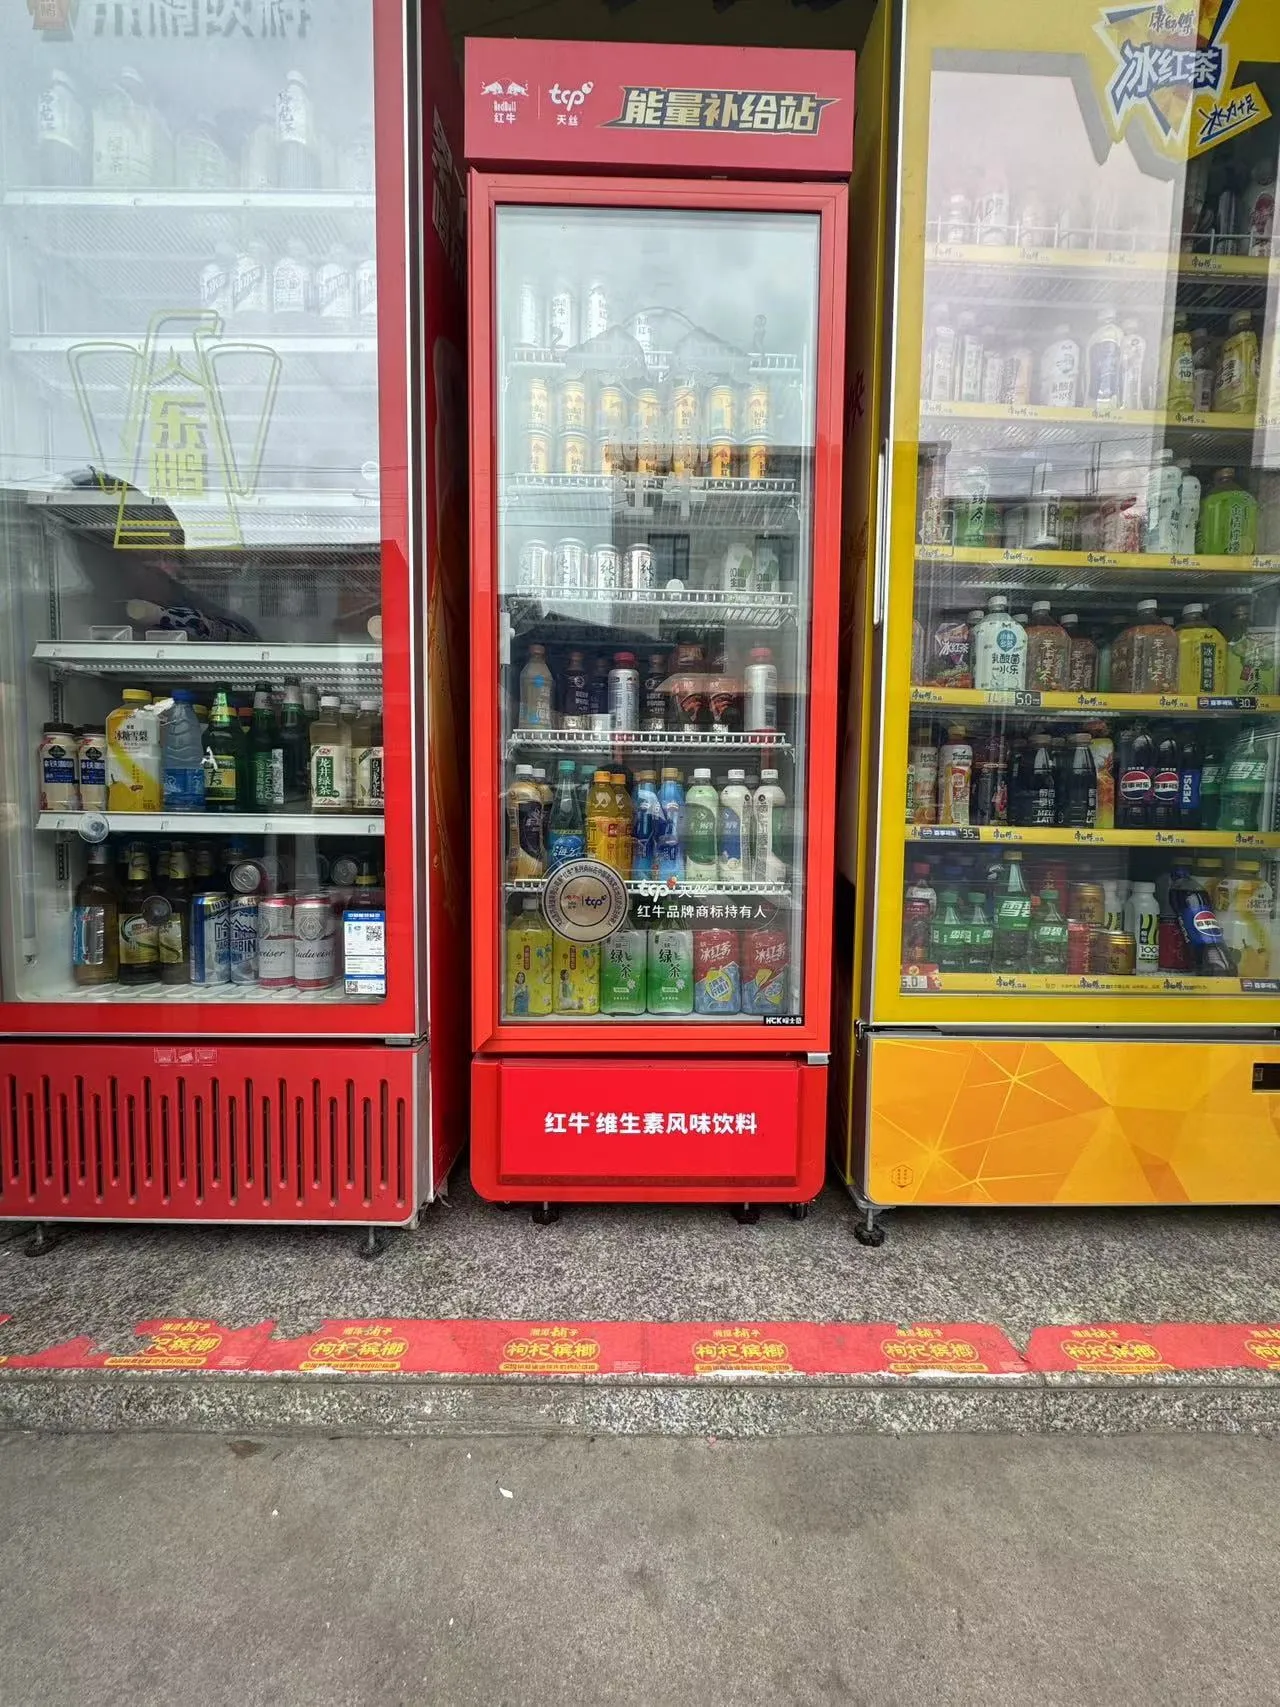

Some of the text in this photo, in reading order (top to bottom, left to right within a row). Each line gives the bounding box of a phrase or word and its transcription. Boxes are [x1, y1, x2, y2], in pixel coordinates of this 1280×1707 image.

[1149, 5, 1195, 35] 康师傅
[1114, 45, 1219, 100] 冰红茶
[548, 83, 586, 111] tcp
[494, 112, 516, 124] 红牛
[619, 90, 817, 131] 能量补给站
[556, 114, 579, 126] 天丝
[152, 391, 205, 497] 东鹏
[939, 641, 969, 657] 冰红茶
[991, 653, 1020, 665] 乳酸菌
[114, 729, 148, 742] 冰糖雪梨
[318, 756, 333, 796] 龙井绿茶
[1183, 774, 1193, 804] PEPSI
[585, 896, 603, 909] tcp
[636, 904, 767, 919] 红牛品牌商标持有人
[611, 949, 633, 979] 绿茶
[658, 949, 682, 978] 绿茶
[311, 1341, 406, 1356] 枸杞槟榔
[506, 1342, 597, 1357] 枸杞槟榔
[695, 1343, 785, 1358] 枸杞槟榔
[884, 1342, 974, 1358] 枸杞槟榔
[1064, 1343, 1156, 1359] 枸杞槟榔
